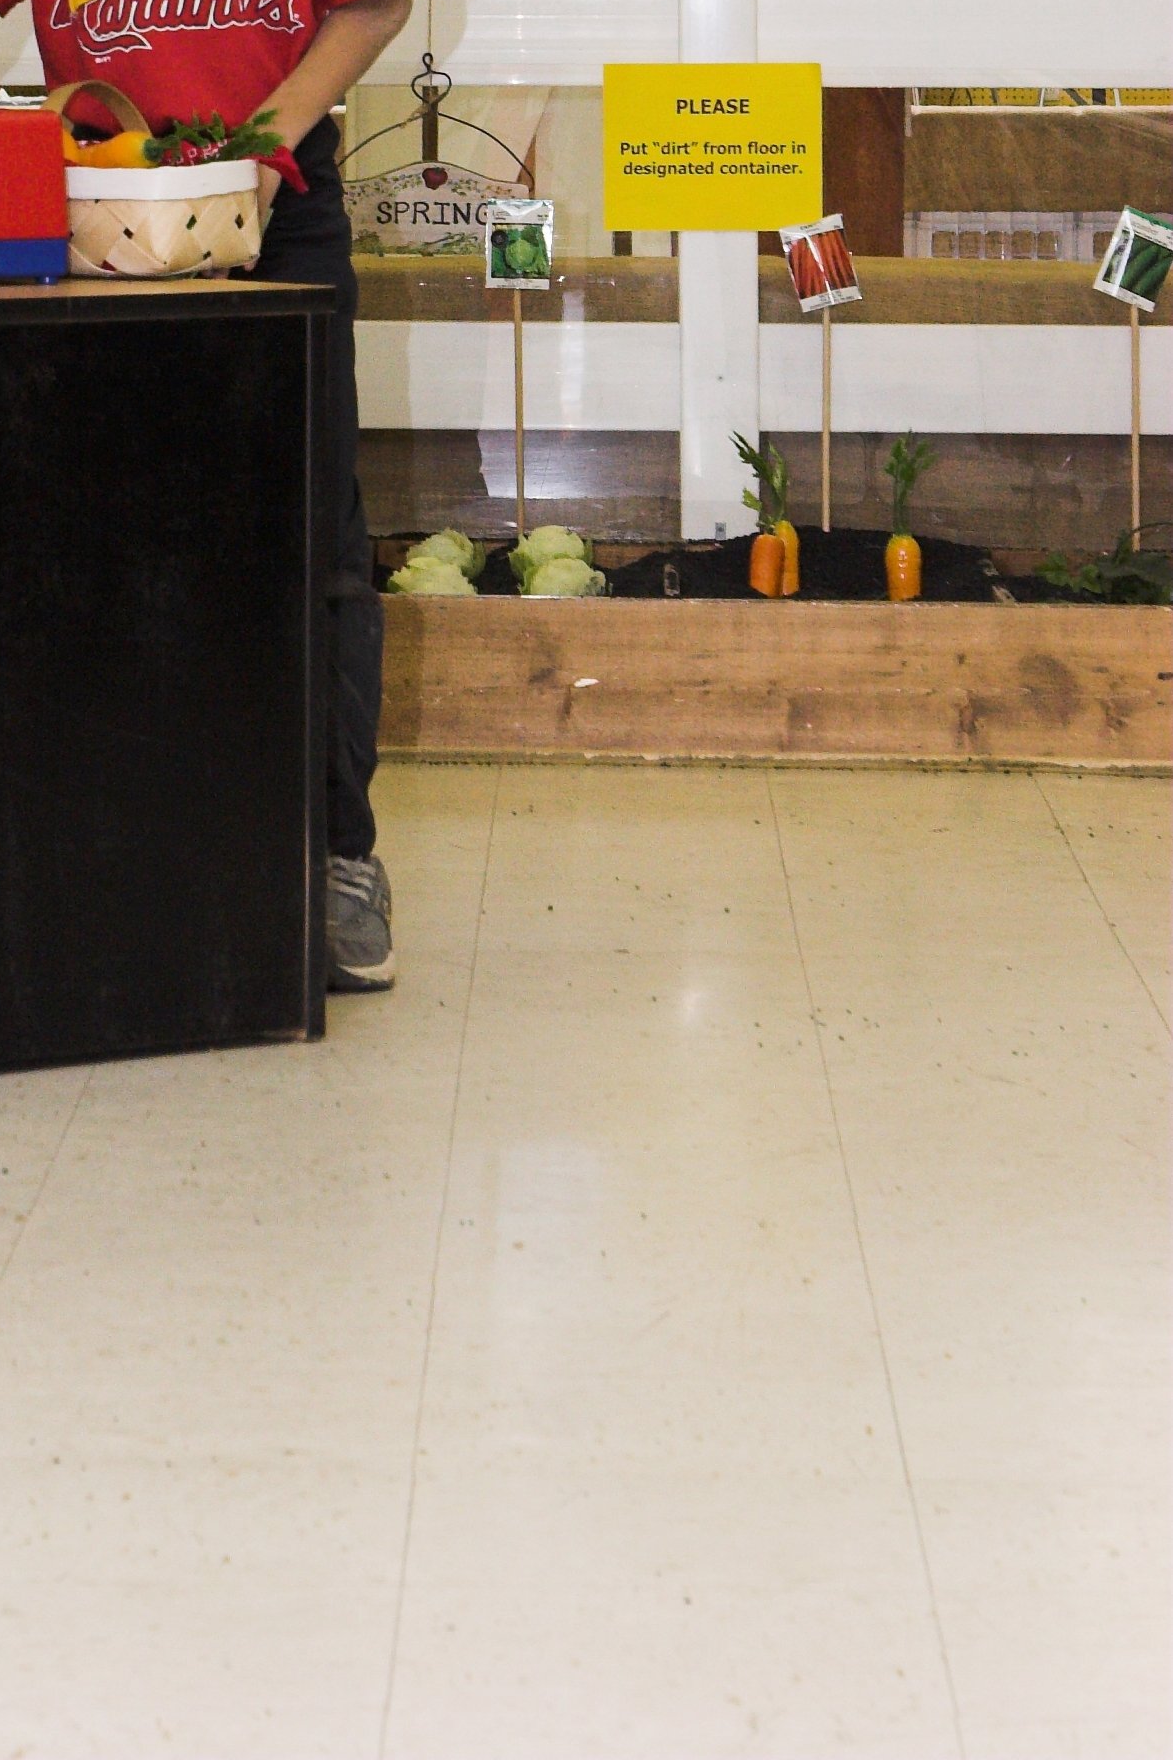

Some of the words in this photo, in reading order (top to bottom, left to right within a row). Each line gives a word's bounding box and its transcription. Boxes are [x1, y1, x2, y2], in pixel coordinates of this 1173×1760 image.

[676, 98, 751, 115] PLEASE
[620, 142, 649, 156] Put
[703, 141, 742, 155] from
[747, 141, 787, 155] floor
[791, 140, 807, 155] in
[623, 161, 715, 178] designated
[719, 161, 804, 175] container.
[376, 201, 489, 226] SPRING
